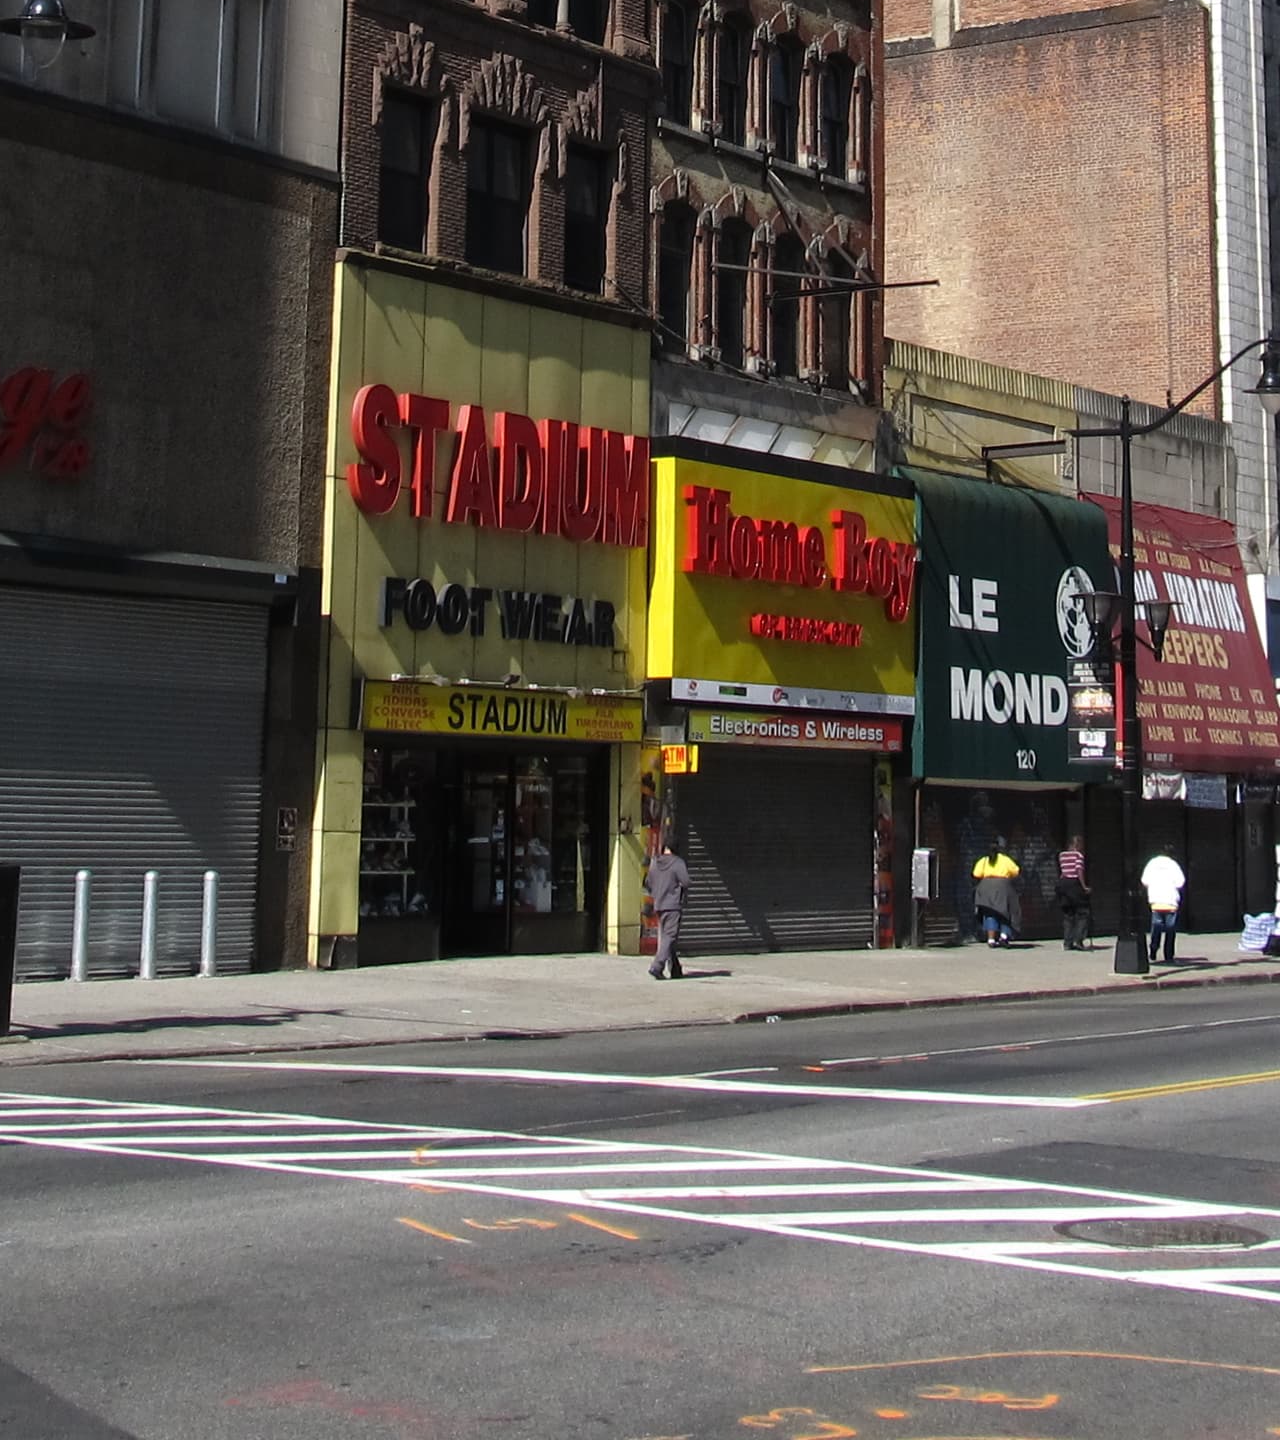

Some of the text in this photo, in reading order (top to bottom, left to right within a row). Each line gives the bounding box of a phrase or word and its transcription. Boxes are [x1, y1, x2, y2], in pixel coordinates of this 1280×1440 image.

[347, 383, 649, 547] STADIUM
[682, 484, 919, 624] Home Boy
[380, 575, 616, 648] FOOT WEAR
[948, 574, 999, 633] LE
[1149, 629, 1229, 669] EEPERS
[374, 706, 436, 720] CONVERSE
[447, 692, 568, 736] STADIUM
[709, 715, 883, 742] Electronics & Wireless
[663, 747, 685, 763] ATM
[1015, 748, 1036, 771] 120
